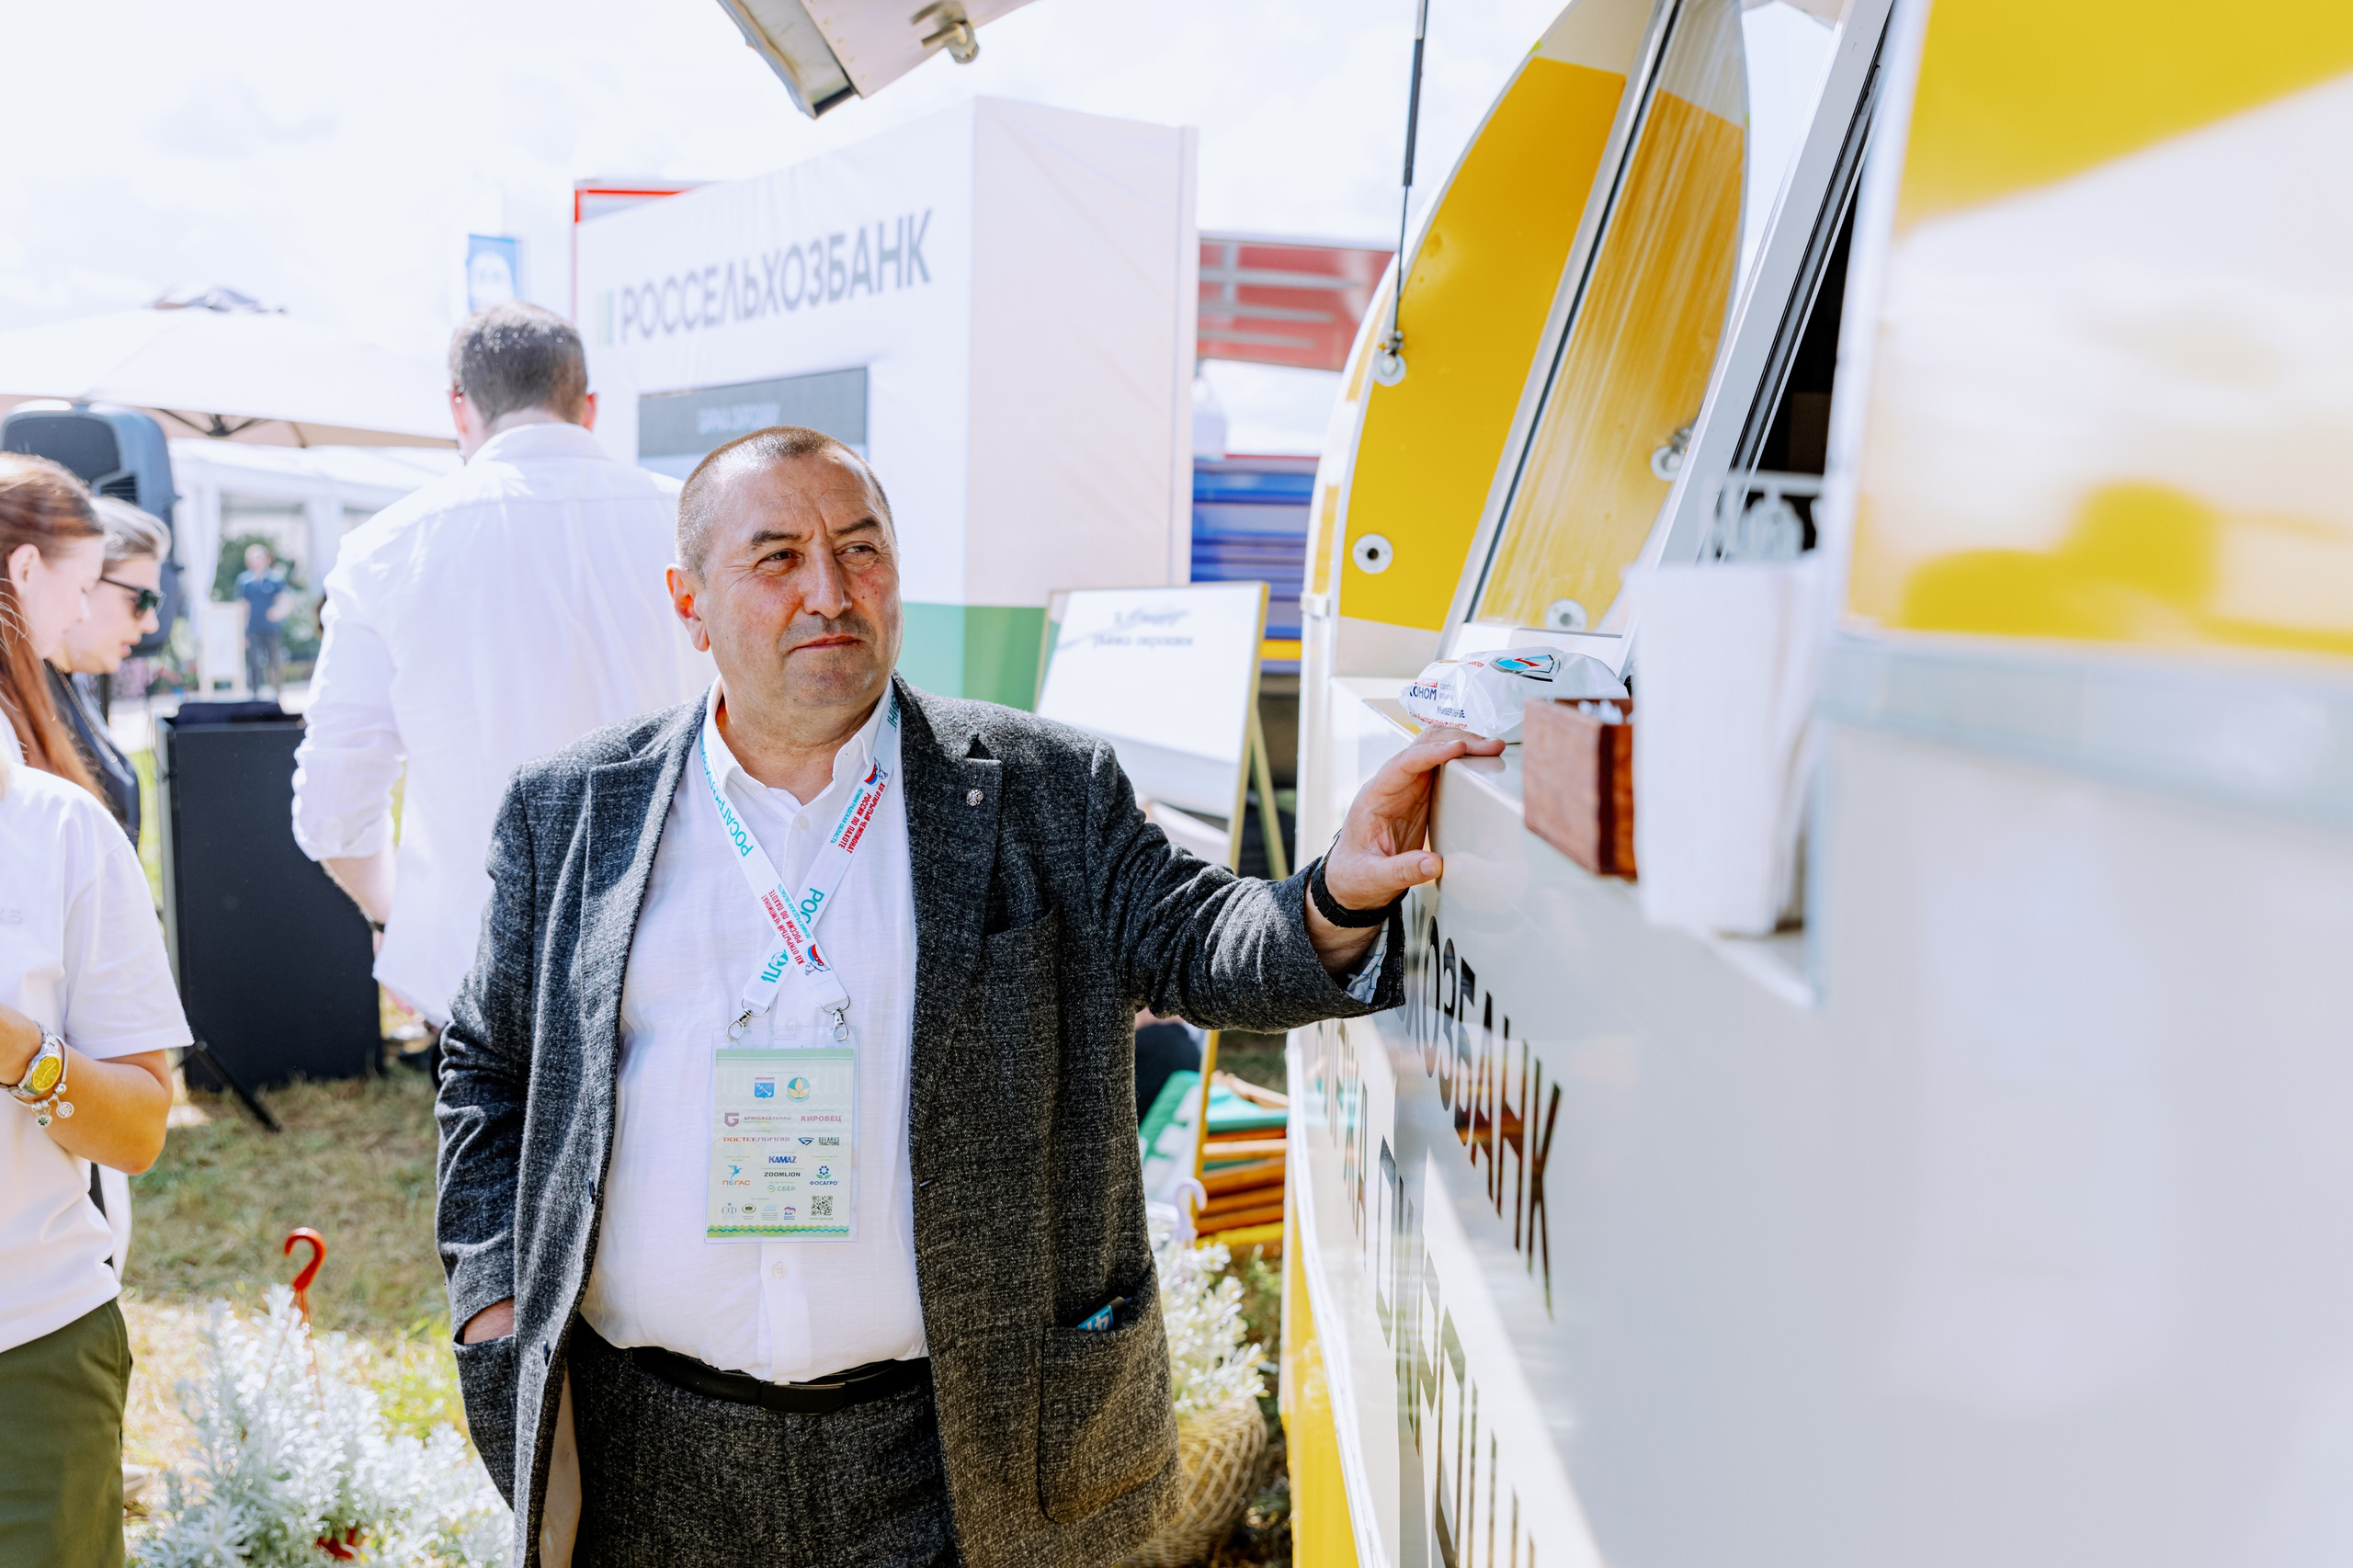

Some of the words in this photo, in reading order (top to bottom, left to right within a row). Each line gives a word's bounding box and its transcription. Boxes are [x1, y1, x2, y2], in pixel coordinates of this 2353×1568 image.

[620, 209, 934, 344] РОССЕЛЬХОЗБАНК
[842, 787, 864, 824] ЛЕНИНГРАДСКАЯ
[856, 792, 872, 816] РОССИИ
[864, 790, 881, 822] ОТКРЫТЫЙ
[850, 815, 860, 826] ПО
[830, 823, 845, 844] ОБЛАСТЬ
[837, 824, 855, 849] ПАХОТЕ
[846, 821, 868, 854] ЧЕМПИОНАТ
[767, 889, 784, 912] ПАХОТЕ
[777, 883, 790, 904] ОБЛАСТЬ
[761, 894, 781, 926] ЧЕМПИОНАТ
[780, 910, 790, 920] ПО
[787, 902, 813, 939] ЛЕНИНГРАДСКАЯ
[777, 924, 800, 955] ОТКРЫТЫЙ
[786, 920, 803, 944] РОССИИ
[1395, 889, 1563, 1322] ХОЗБАНК
[768, 1155, 797, 1164] KAMAZ
